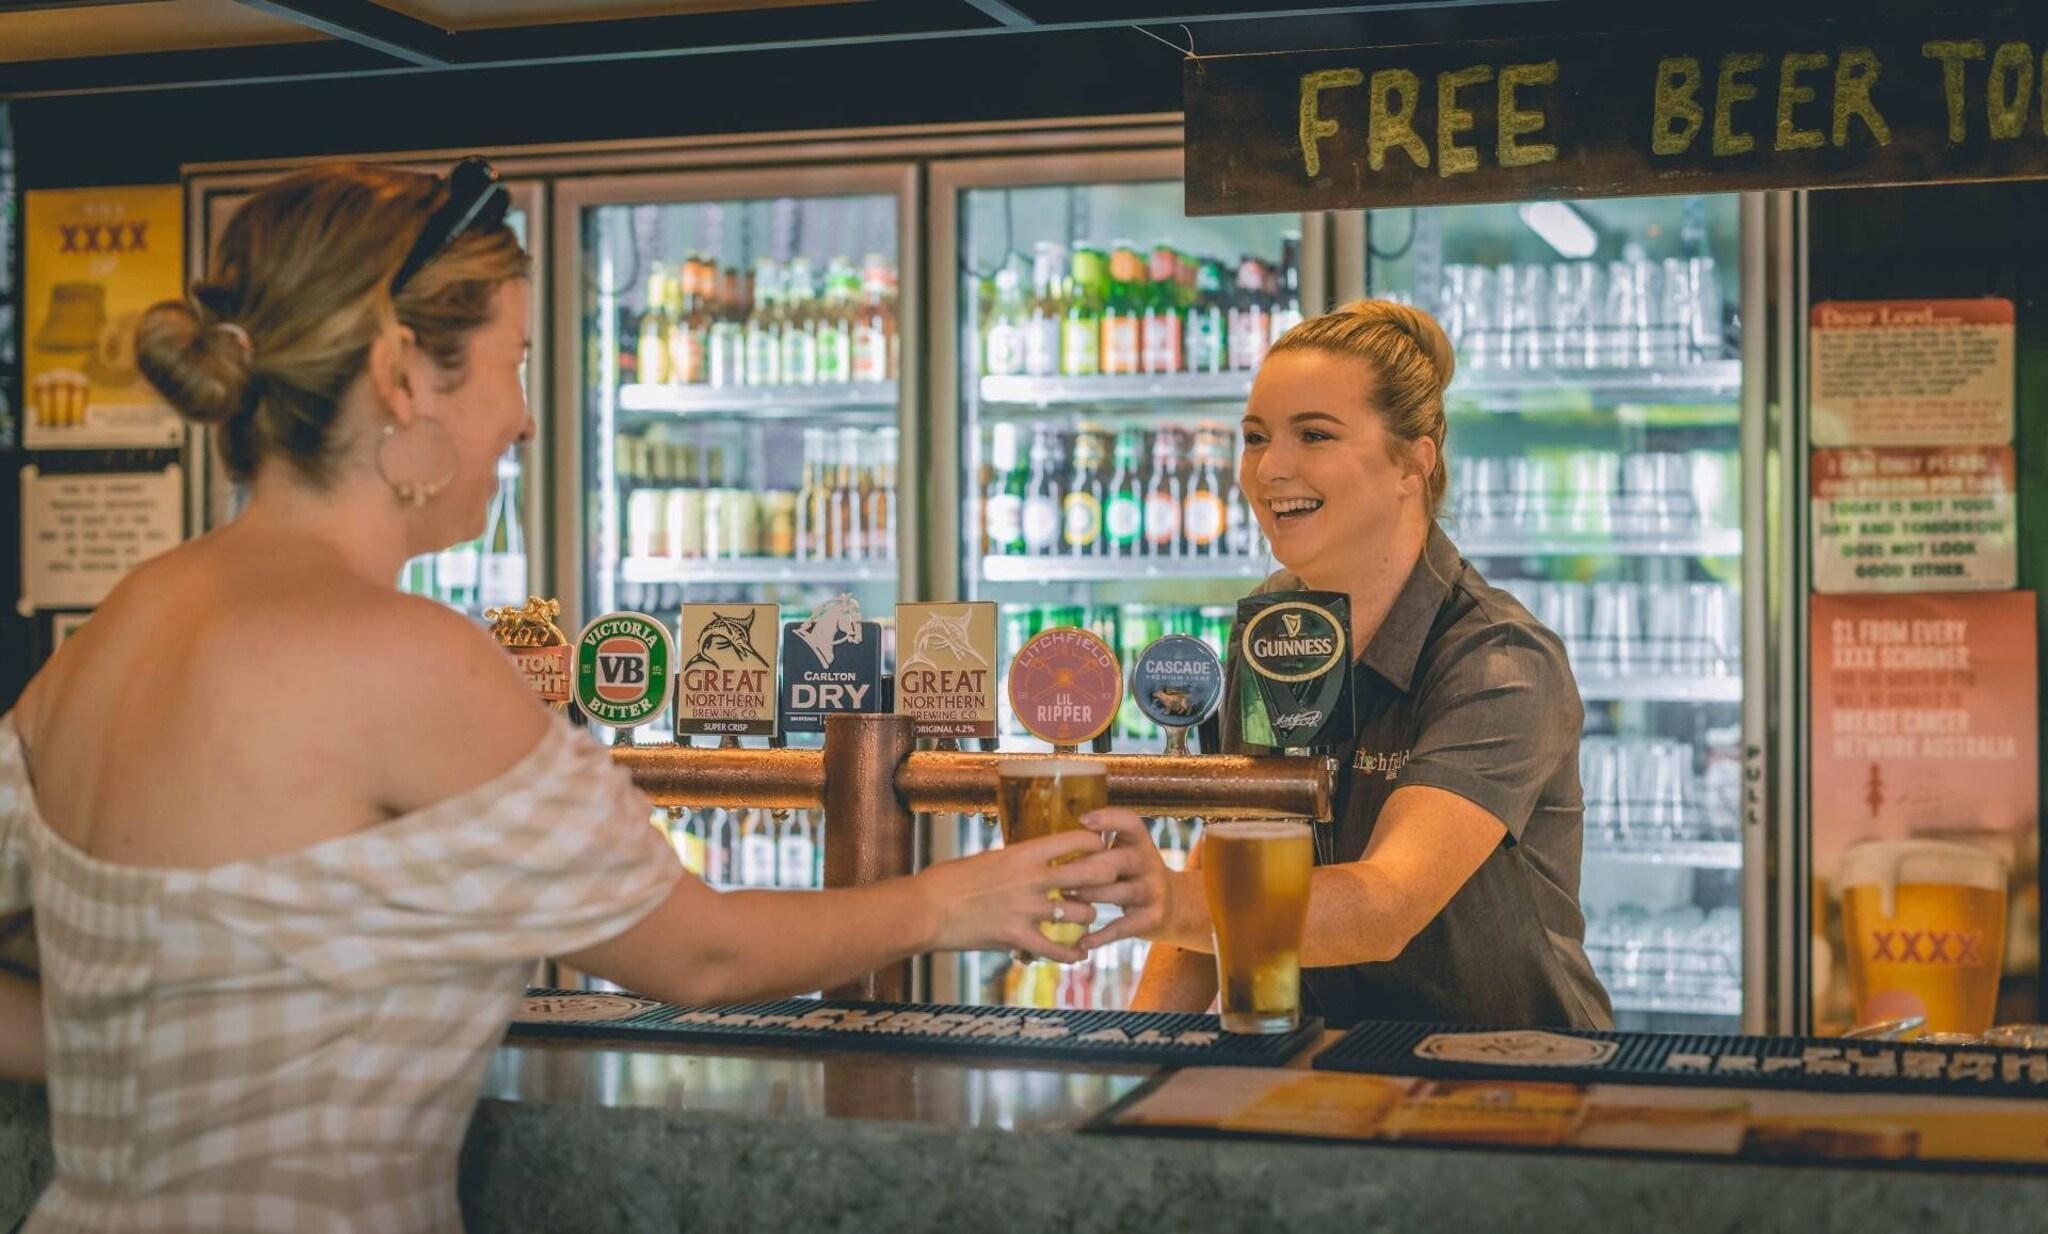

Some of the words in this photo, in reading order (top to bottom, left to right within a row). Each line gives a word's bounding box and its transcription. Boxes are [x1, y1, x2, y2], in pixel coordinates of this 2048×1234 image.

[1299, 59, 1559, 177] FREE
[1652, 45, 1893, 157] BEER
[1922, 38, 2048, 144] TO
[59, 221, 149, 254] XXXX
[584, 621, 658, 649] VICTORIA
[1019, 632, 1111, 669] LITCHFIELD
[1254, 638, 1333, 658] GUINNESS
[598, 655, 644, 684] VB
[804, 671, 856, 682] CARLTON
[1145, 660, 1211, 675] CASCADE
[684, 669, 768, 692] GREAT
[901, 669, 987, 694] GREAT
[685, 693, 765, 708] NORTHERN
[791, 684, 870, 709] DRY
[903, 694, 985, 709] NORTHERN
[1056, 693, 1073, 706] LIL
[588, 697, 653, 719] BITTER
[692, 708, 737, 719] BREWING
[911, 710, 957, 720] BREWING
[1037, 705, 1092, 722] RIPPER
[703, 723, 726, 732] SUPER
[727, 723, 749, 732] CRISP
[1870, 929, 1983, 967] XXXX
